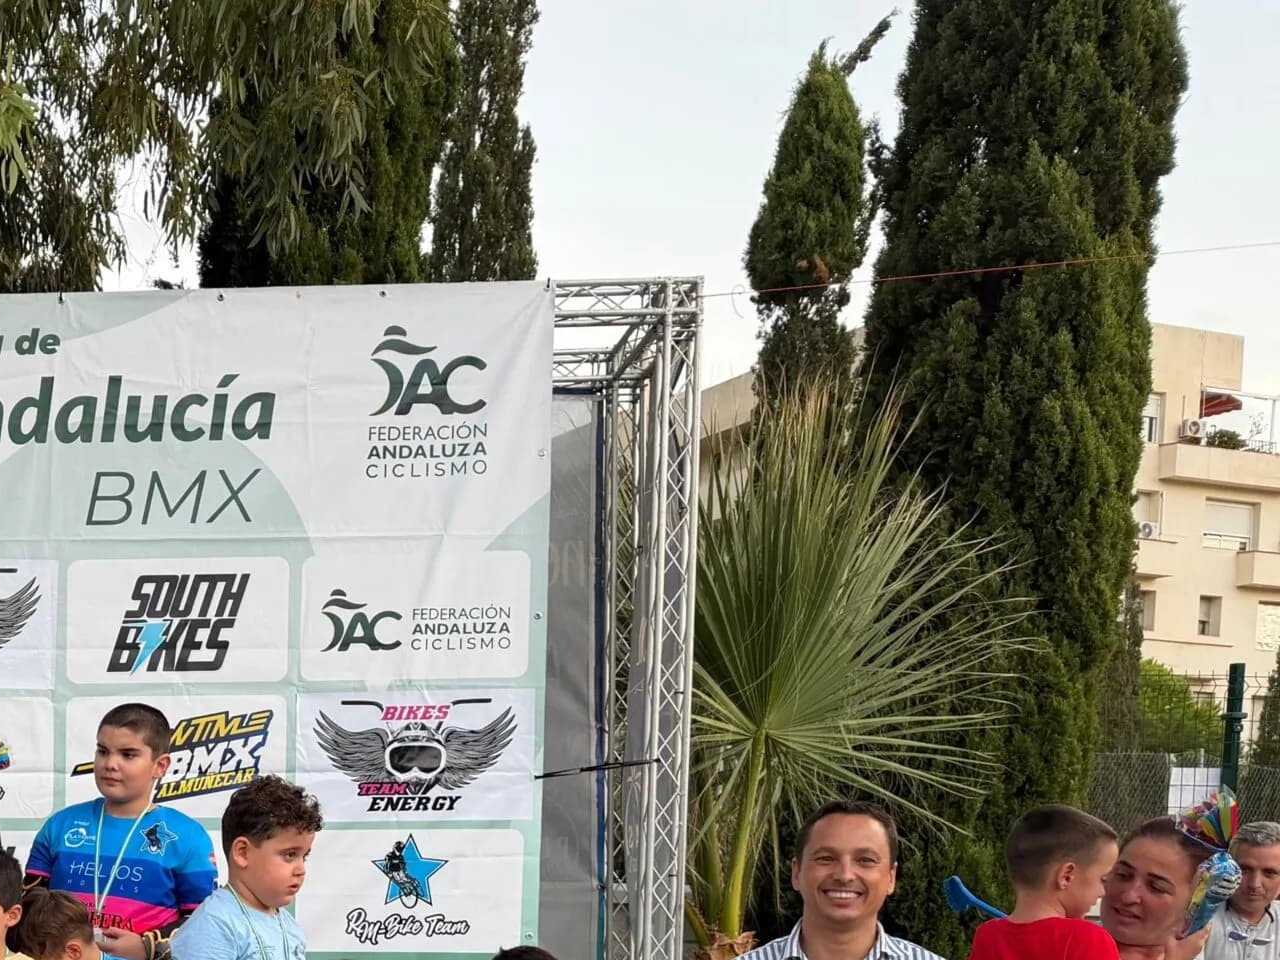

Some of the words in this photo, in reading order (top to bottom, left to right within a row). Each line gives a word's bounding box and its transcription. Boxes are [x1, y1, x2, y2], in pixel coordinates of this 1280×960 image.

[15, 328, 61, 356] de
[368, 421, 488, 442] FEDERACIÓN
[367, 441, 488, 460] ANDALUZA
[365, 459, 488, 479] CICLISMO
[85, 467, 262, 527] BMX
[124, 573, 251, 619] SOUTH
[412, 604, 511, 621] FEDERACIÓN
[411, 622, 511, 636] ANDALUZA
[410, 636, 511, 651] CICLISMO
[380, 704, 451, 721] BIKES
[161, 734, 267, 784] BMX
[358, 782, 409, 796] TEAM
[367, 795, 462, 812] ENERGY
[69, 861, 144, 882] HELOS
[424, 913, 471, 938] Team
